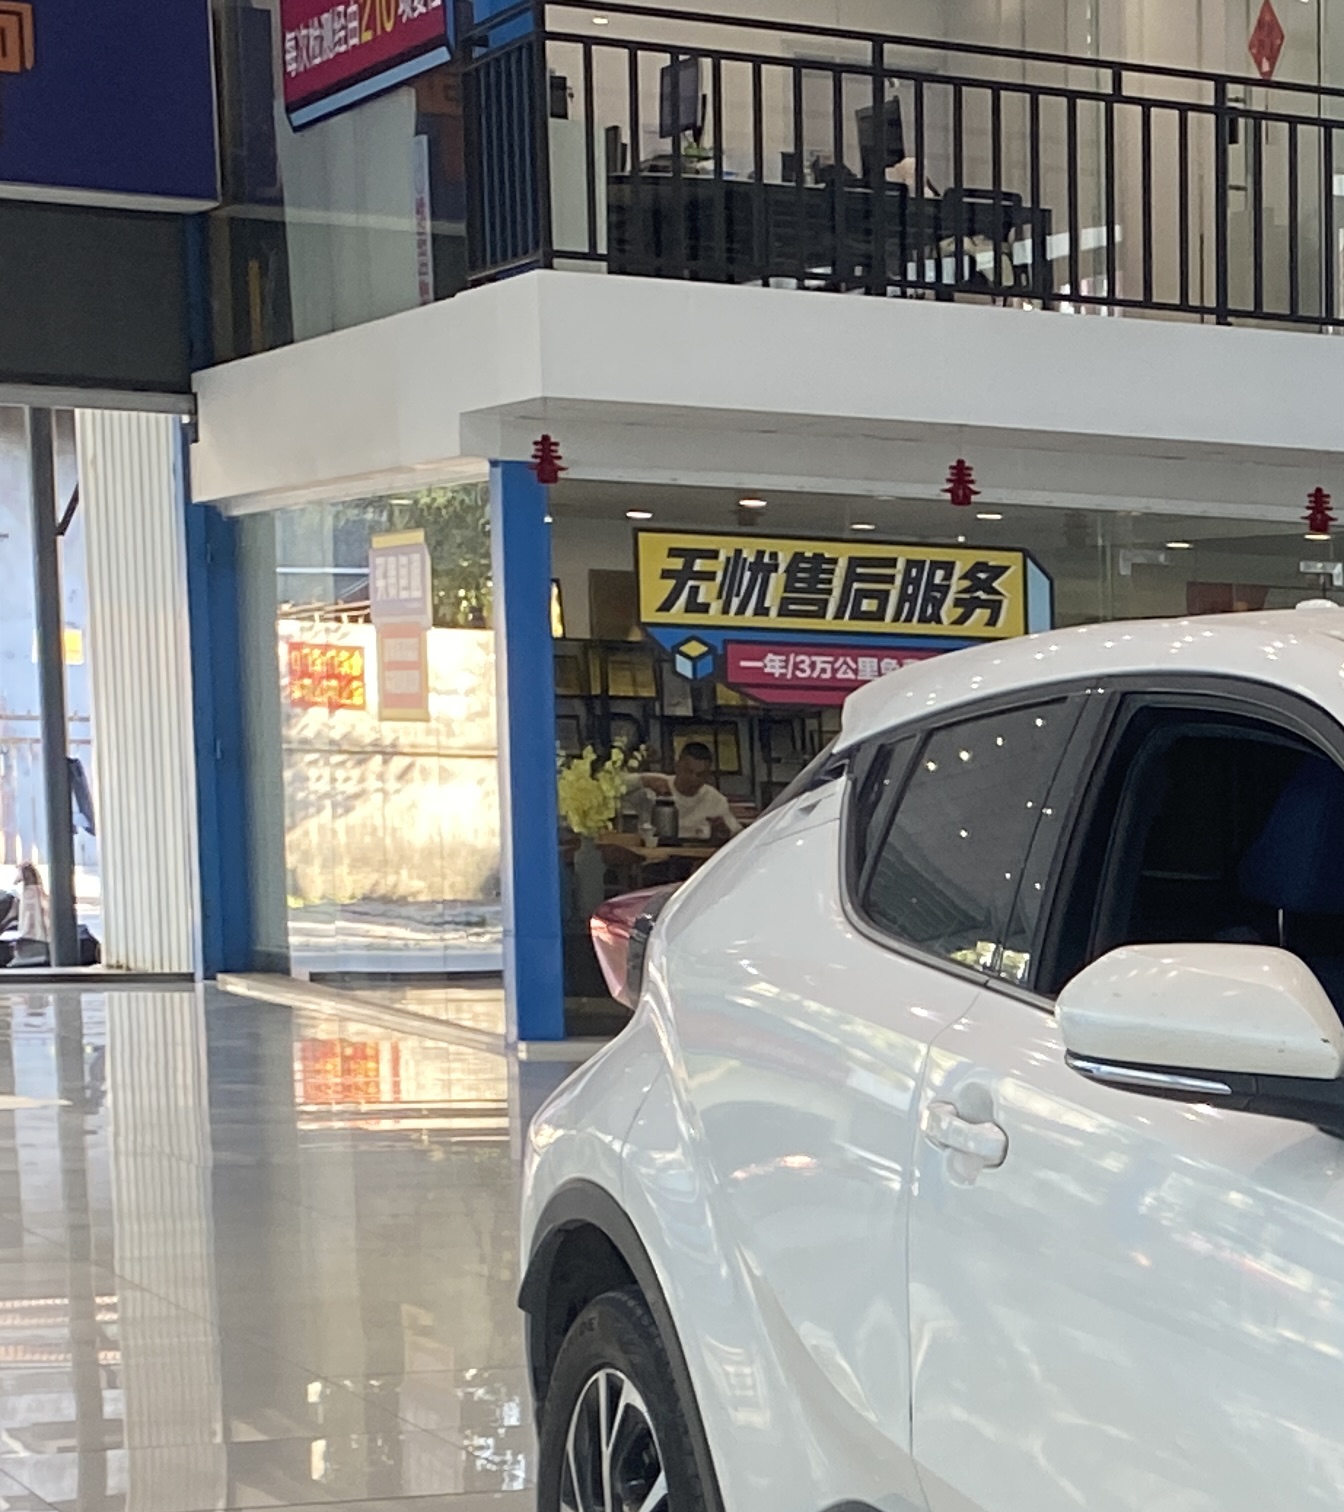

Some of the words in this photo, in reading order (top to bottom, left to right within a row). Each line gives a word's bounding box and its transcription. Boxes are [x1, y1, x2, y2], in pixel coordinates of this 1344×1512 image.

[655, 546, 1013, 628] 无忧售后服务
